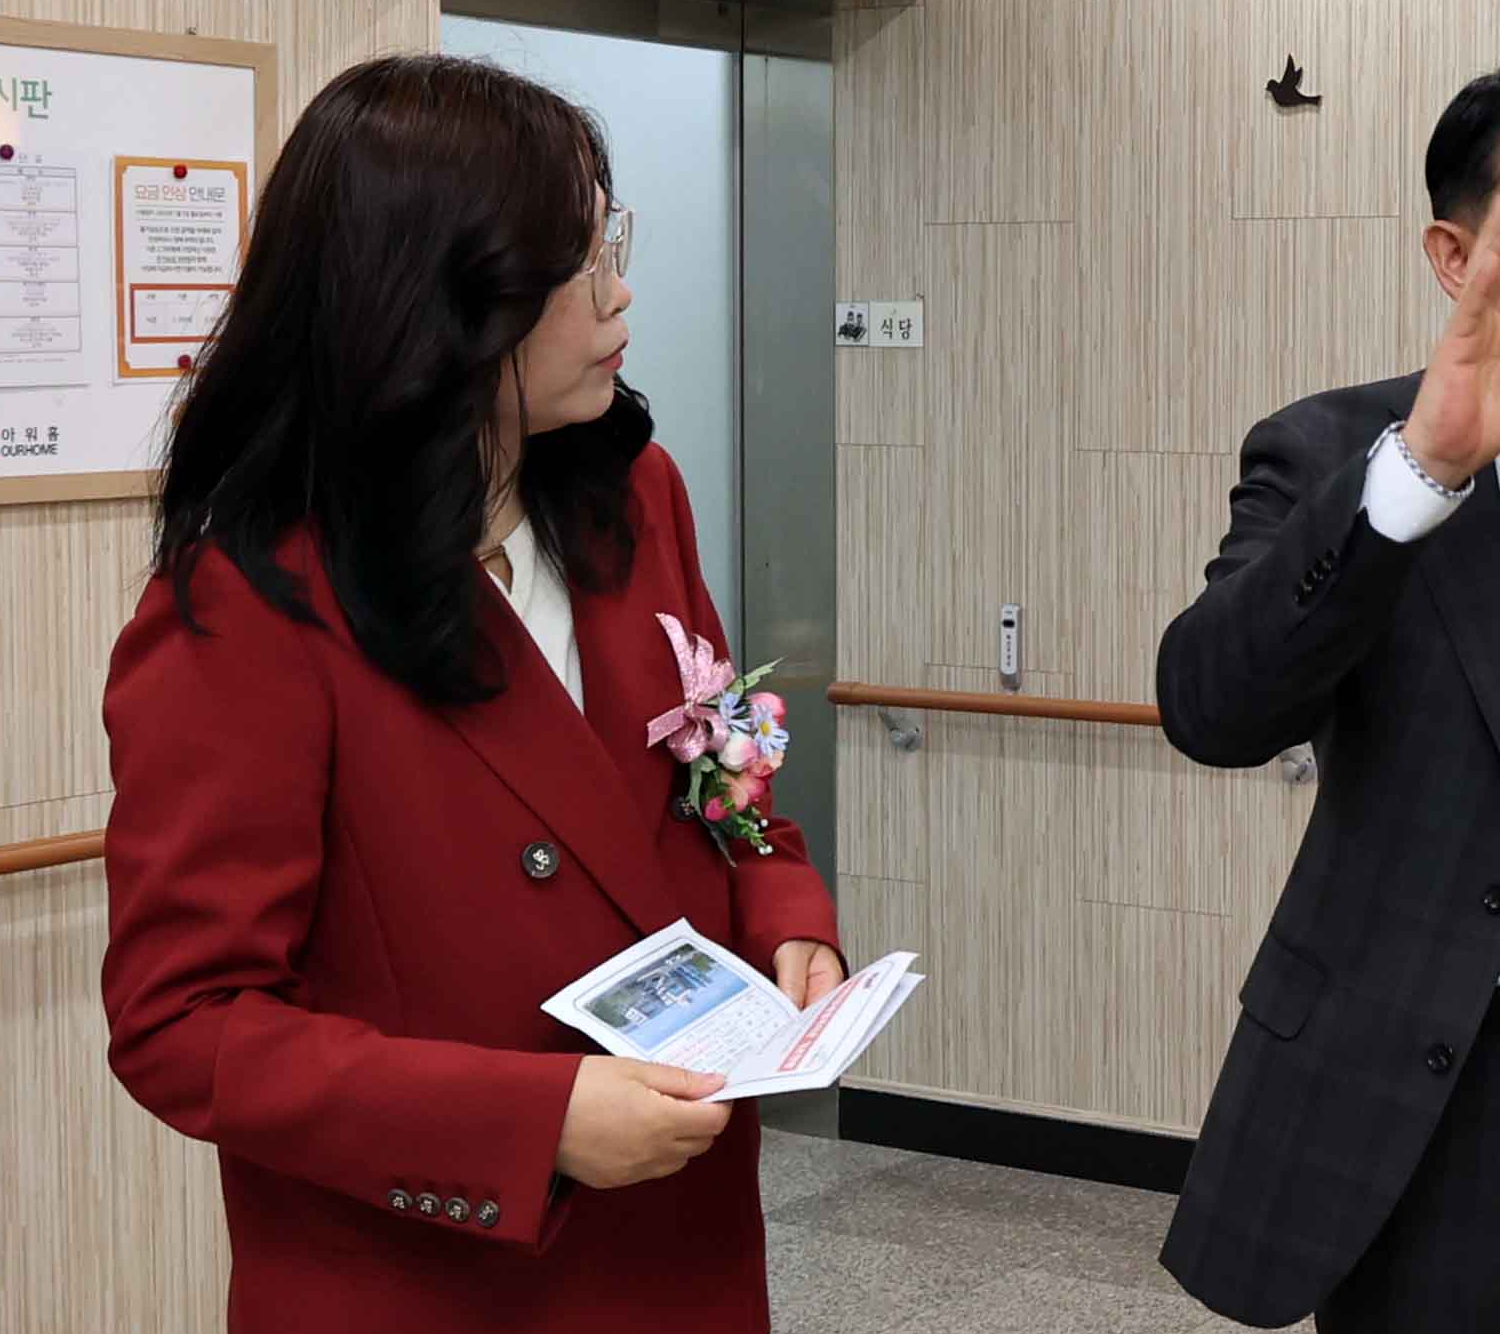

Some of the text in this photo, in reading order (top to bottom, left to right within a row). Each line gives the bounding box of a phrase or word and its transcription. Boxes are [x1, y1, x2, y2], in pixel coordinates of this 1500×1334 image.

[881, 318, 913, 340] 식당
[1, 426, 59, 442] 아워홈
[1, 443, 59, 457] OURHOME
